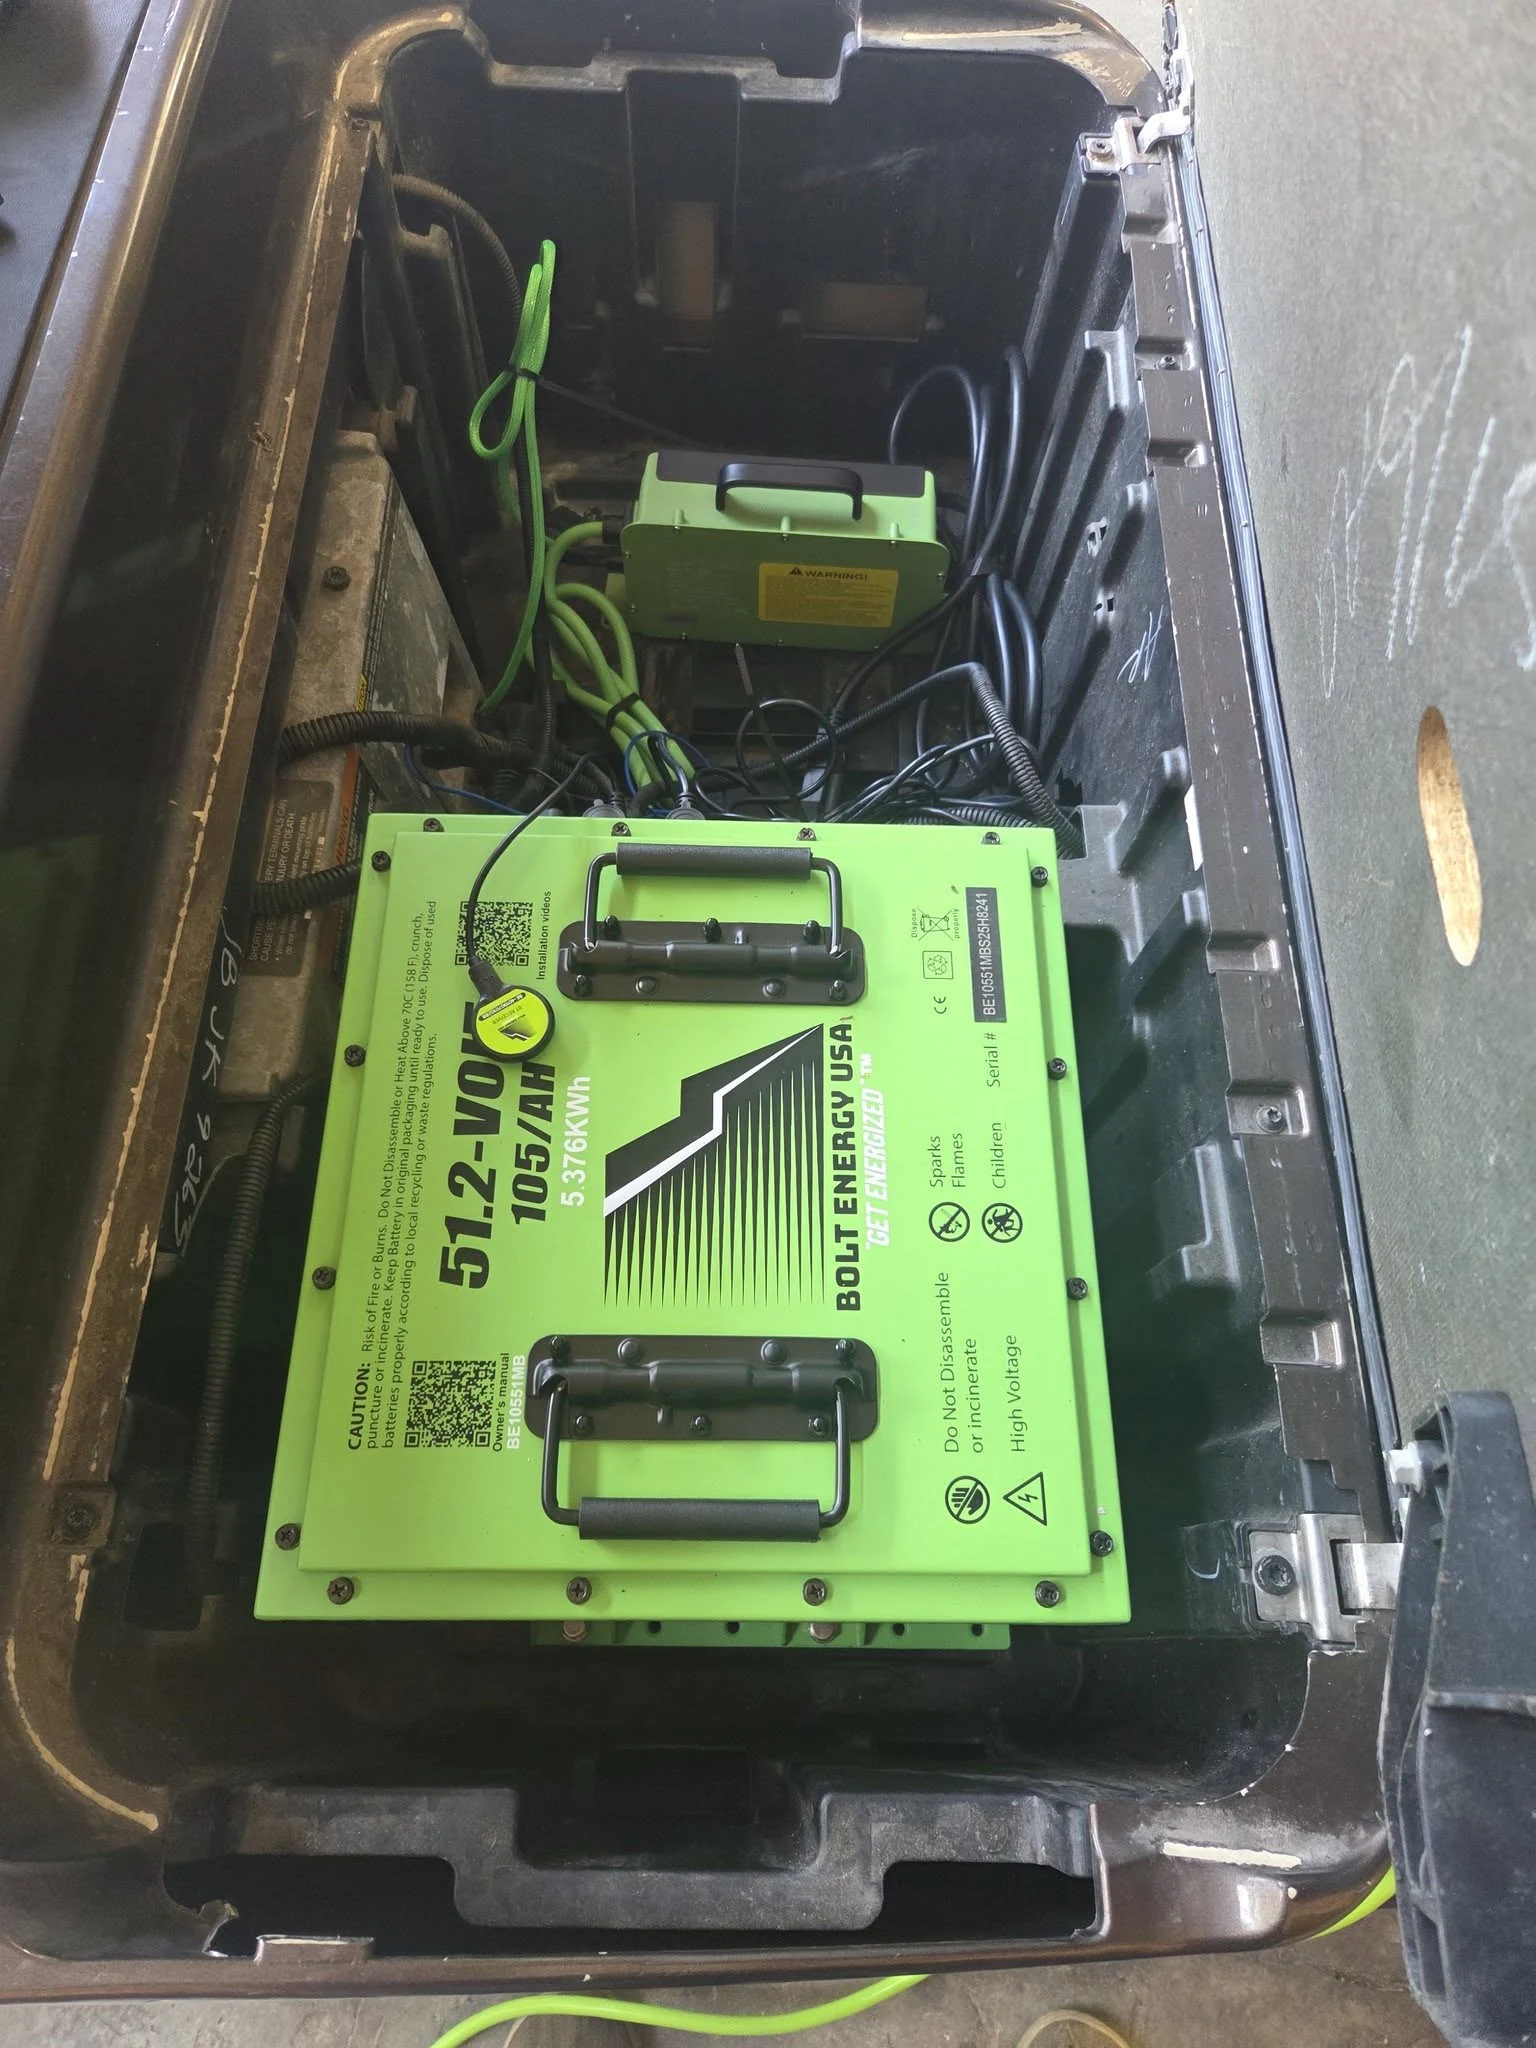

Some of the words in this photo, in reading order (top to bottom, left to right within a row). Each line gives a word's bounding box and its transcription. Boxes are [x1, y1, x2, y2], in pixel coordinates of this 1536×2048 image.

[805, 570, 868, 581] WARNING!
[261, 932, 273, 961] CAUSE
[282, 841, 291, 853] OR
[426, 901, 436, 925] used
[540, 891, 551, 923] videos
[424, 927, 433, 938] of
[952, 908, 960, 939] properly
[418, 941, 432, 982] Dispose
[535, 925, 549, 980] Installation
[976, 893, 996, 1015] BE10551MBS25H8241
[405, 969, 416, 992] (158
[418, 986, 427, 1006] use.
[402, 995, 414, 1014] 70C
[415, 1009, 425, 1020] to
[397, 1018, 411, 1053] Above
[412, 1023, 426, 1054] ready
[829, 1024, 853, 1081] USA
[984, 1032, 997, 1040] #
[394, 1056, 407, 1082] Heat
[409, 1057, 419, 1082] until
[422, 1033, 437, 1099] regulations.
[984, 1046, 1000, 1087] Serial
[394, 1085, 403, 1097] or
[402, 1086, 419, 1145] packaging
[419, 1102, 429, 1135] waste
[383, 1100, 401, 1172] Disassemble
[417, 1138, 425, 1151] or
[439, 1001, 505, 1290] 51.2-VO
[511, 1060, 555, 1225] 105/AH
[560, 1076, 591, 1208] 5.376KWh
[831, 1091, 857, 1214] ENERGY
[990, 1122, 1006, 1189] Children
[396, 1149, 410, 1194] original
[927, 1136, 946, 1188] Sparks
[951, 1133, 965, 1188] Flames
[380, 1176, 393, 1197] Not
[411, 1154, 427, 1208] recycling
[377, 1201, 390, 1218] Do
[393, 1197, 404, 1208] in
[372, 1224, 387, 1263] Burns.
[387, 1211, 405, 1255] Battery
[405, 1212, 418, 1240] local
[404, 1243, 415, 1256] to
[834, 1224, 860, 1311] BOLT
[373, 1266, 382, 1280] or
[383, 1259, 399, 1291] Keep
[399, 1260, 416, 1324] according
[367, 1283, 380, 1306] Fire
[366, 1309, 377, 1323] of
[374, 1296, 393, 1363] incinerate.
[935, 1272, 954, 1381] Disassemble
[361, 1326, 375, 1352] Risk
[392, 1327, 408, 1383] properly
[375, 1367, 384, 1382] or
[964, 1338, 981, 1428] incinerate
[1005, 1335, 1021, 1403] Voltage
[348, 1363, 371, 1450] CAUTION:
[367, 1385, 383, 1449] puncture
[381, 1387, 400, 1448] batteries
[492, 1401, 506, 1452] Owner's
[499, 1352, 510, 1397] manual
[506, 1355, 526, 1449] BE10551MB
[942, 1387, 957, 1420] Not
[944, 1427, 959, 1452] Do
[971, 1434, 983, 1453] or
[1008, 1409, 1028, 1452] High
